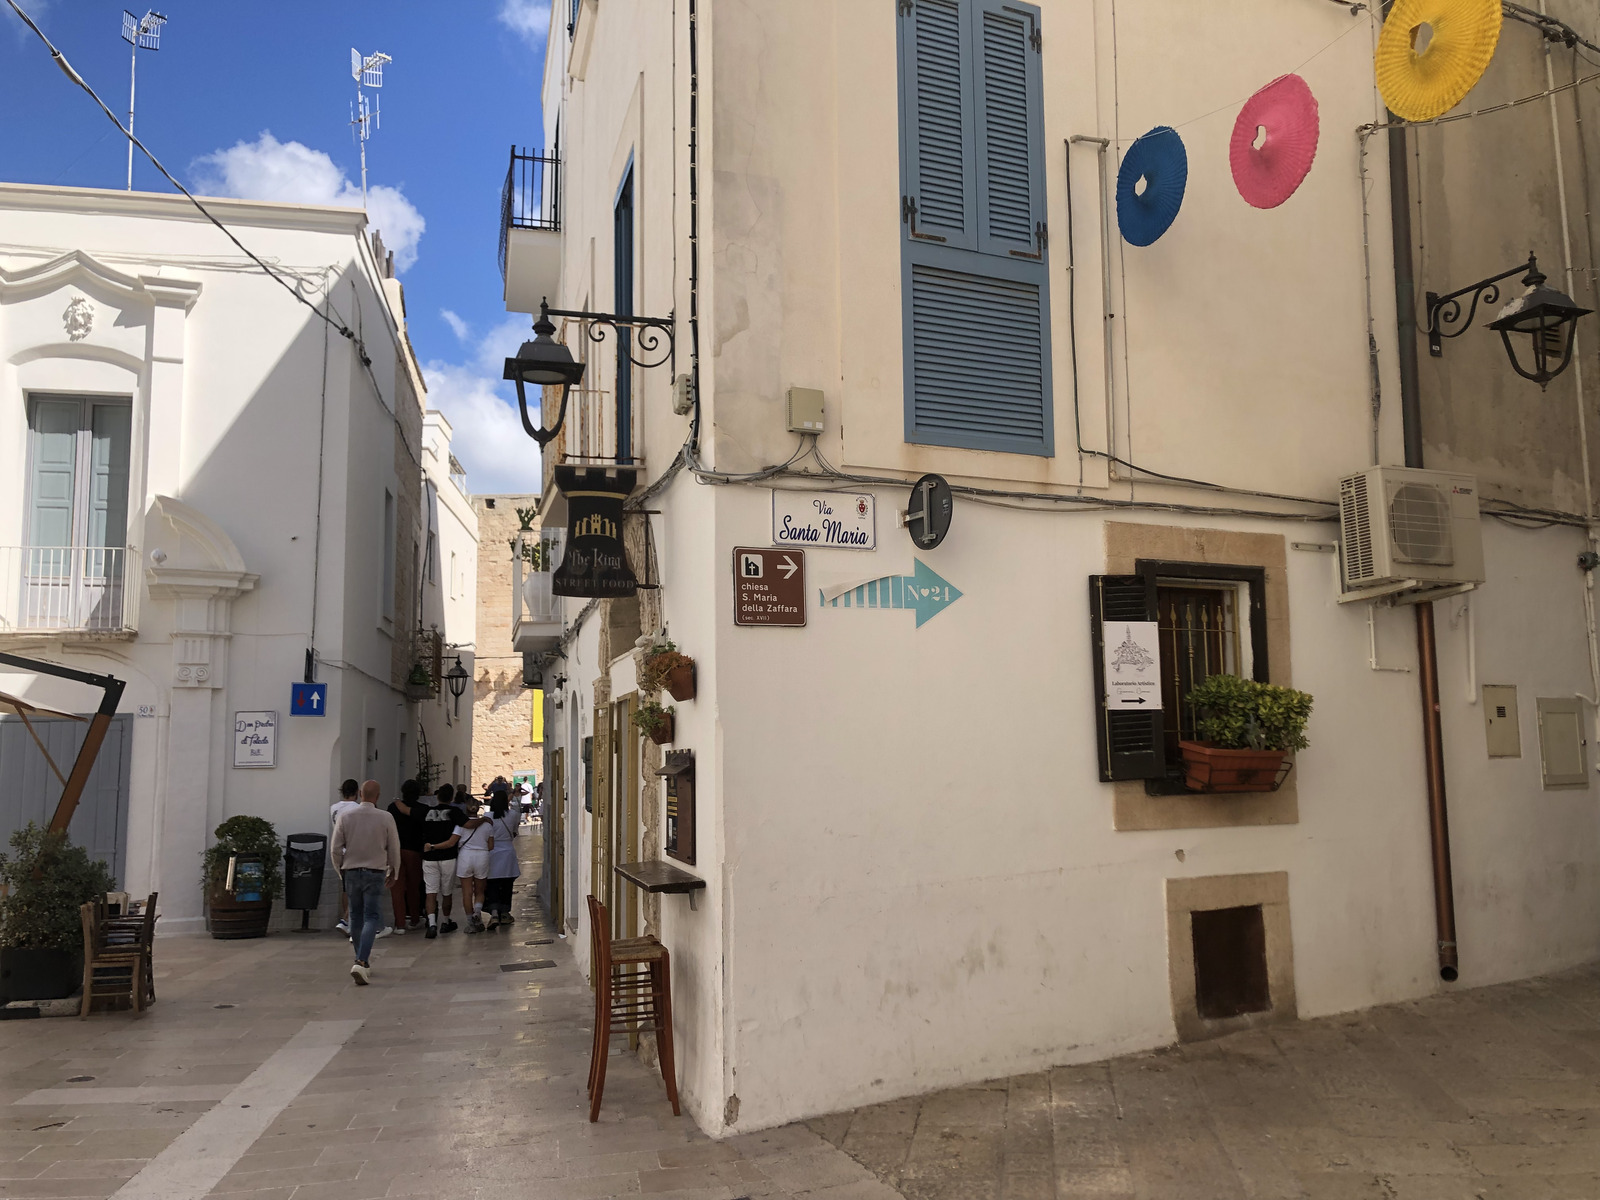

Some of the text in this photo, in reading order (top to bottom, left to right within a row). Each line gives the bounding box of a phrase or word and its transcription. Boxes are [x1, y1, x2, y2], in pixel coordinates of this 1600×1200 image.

[813, 500, 834, 515] Via
[779, 515, 869, 545] Santa Maria
[568, 547, 621, 569] The King
[555, 578, 634, 588] STREET FOOD
[741, 583, 769, 591] chiesa
[742, 593, 778, 602] S. Maria
[741, 604, 798, 613] della Zaffara
